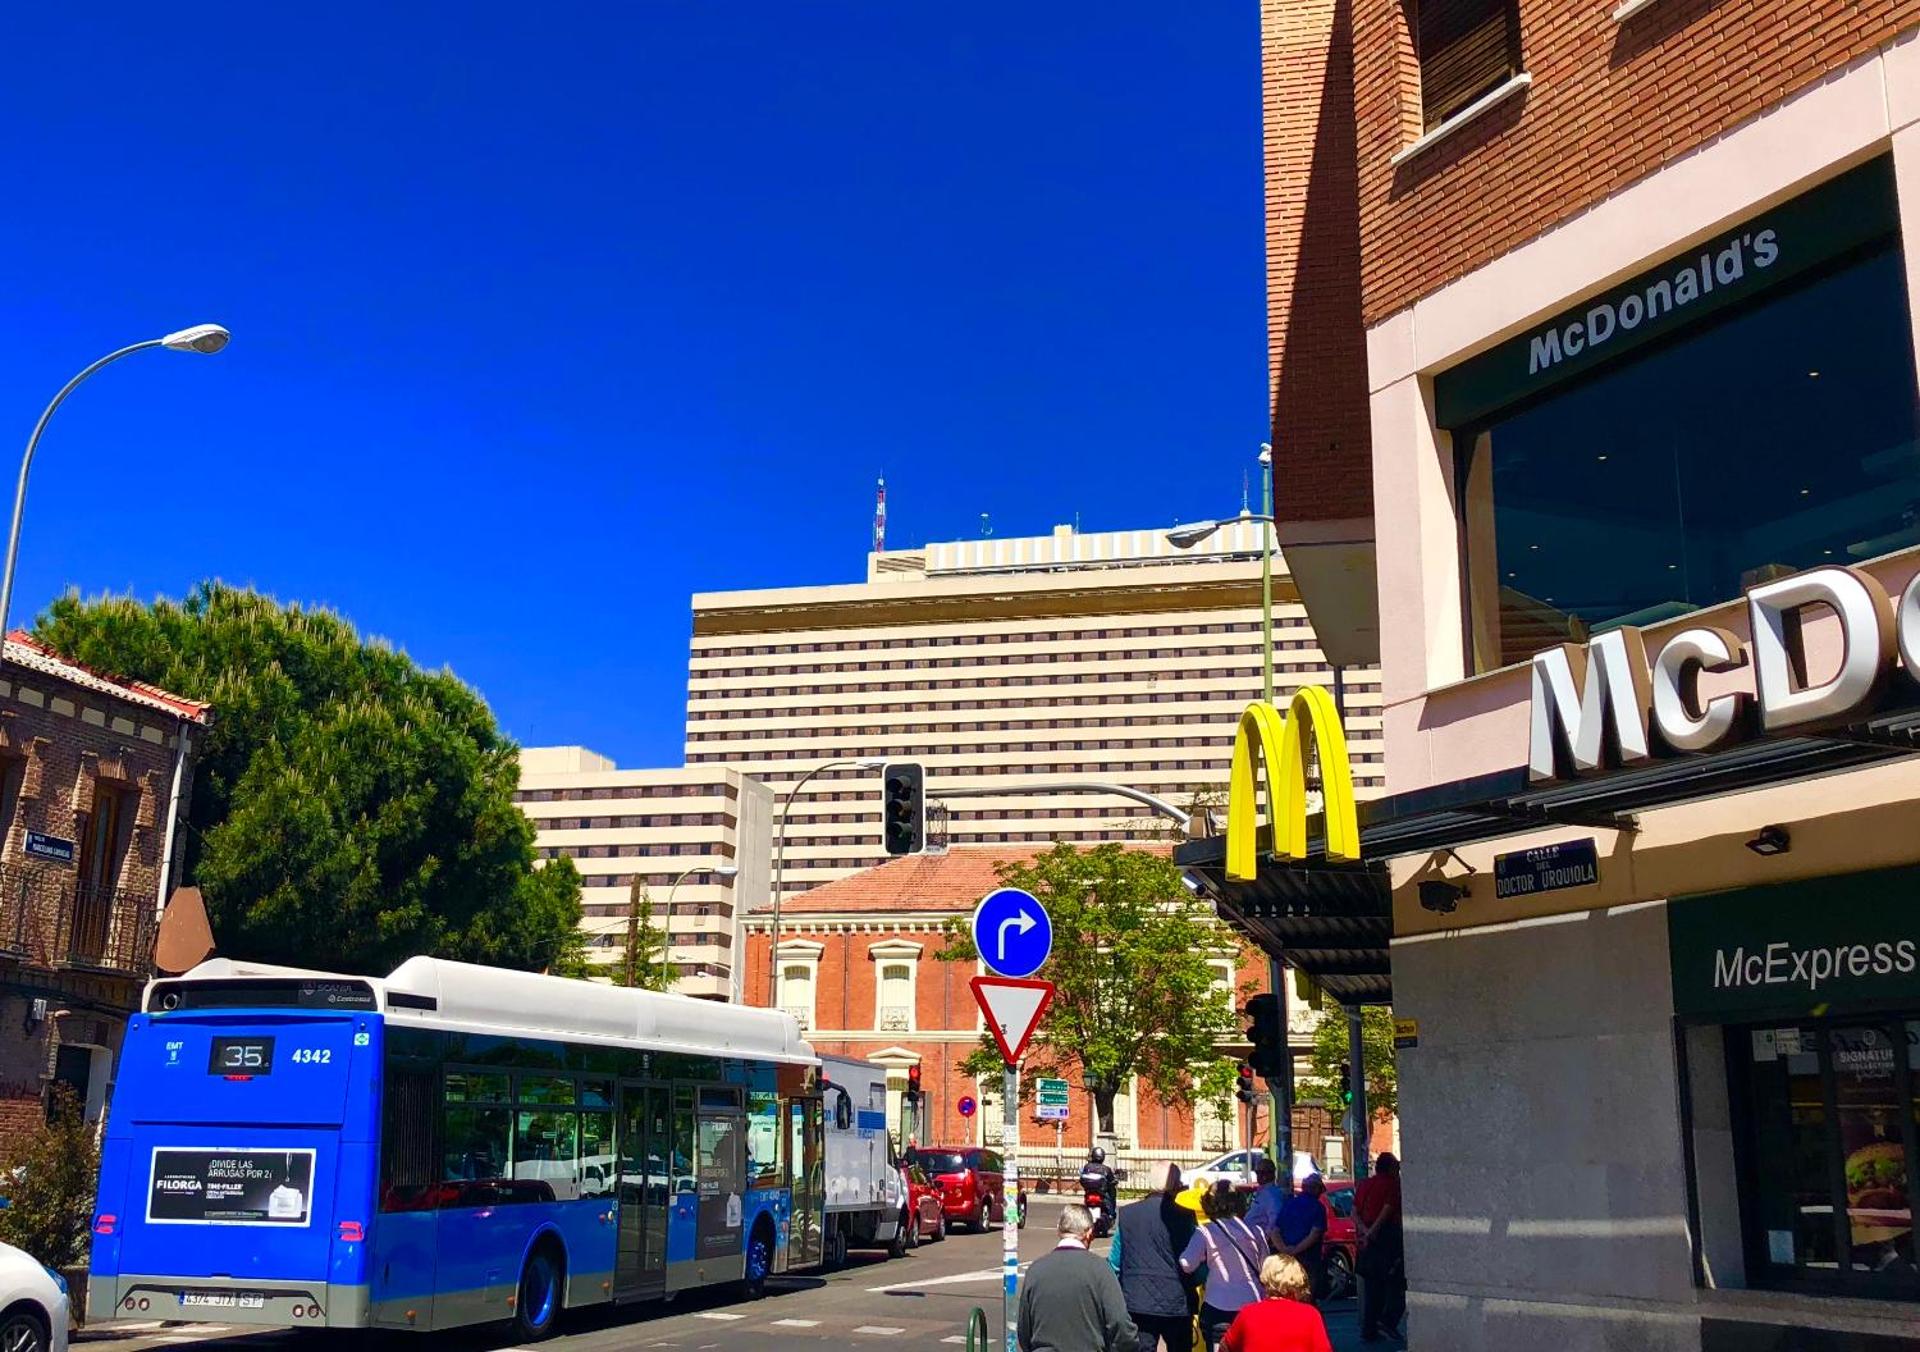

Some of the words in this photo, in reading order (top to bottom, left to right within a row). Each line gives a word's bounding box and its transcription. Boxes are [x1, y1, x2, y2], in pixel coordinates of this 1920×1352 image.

[1528, 228, 1780, 376] McDonald's
[1529, 566, 1920, 782] McD
[1526, 845, 1560, 864] CALLE
[1497, 874, 1535, 897] DOCTOR
[1541, 862, 1596, 889] URQUIOLA
[1713, 938, 1917, 990] McExpress
[224, 1045, 263, 1068] 35
[291, 1048, 331, 1064] 4342
[207, 1169, 245, 1178] ARRUGAS
[246, 1169, 263, 1179] POR
[238, 1160, 253, 1169] LAS
[156, 1180, 203, 1190] FILORGA
